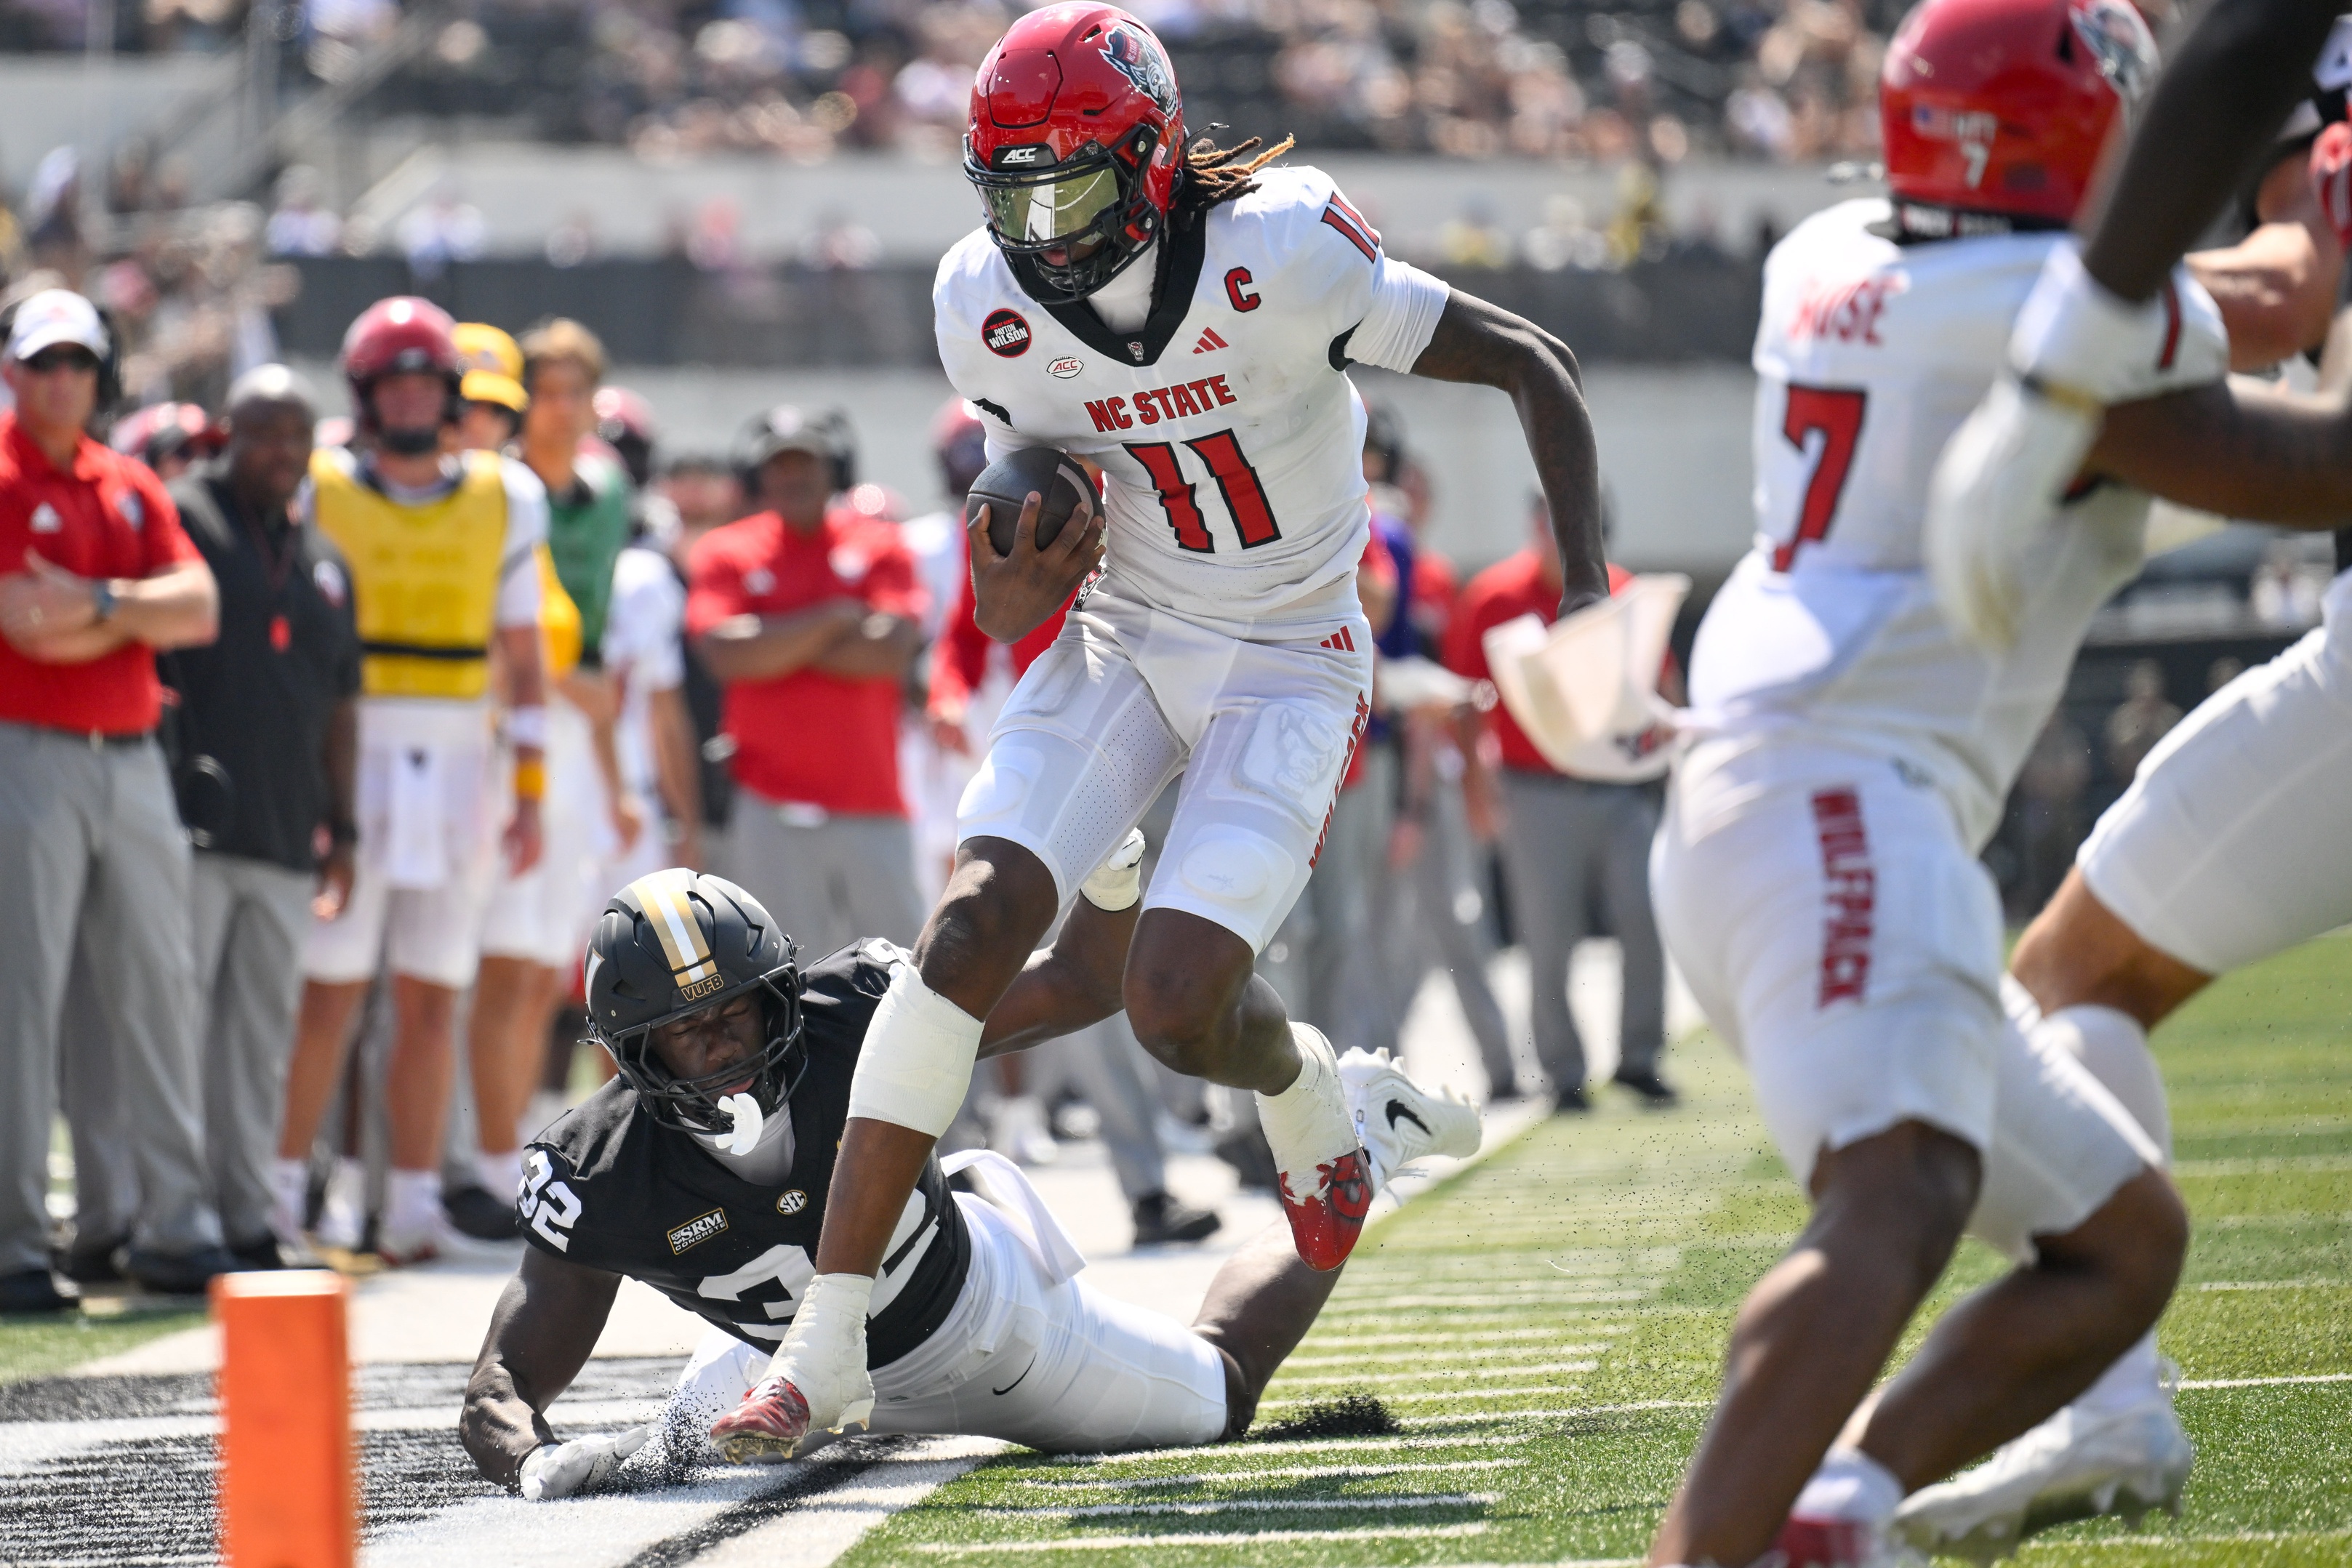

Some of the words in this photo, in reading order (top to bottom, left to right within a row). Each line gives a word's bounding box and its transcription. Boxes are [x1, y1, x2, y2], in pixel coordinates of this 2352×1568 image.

[1003, 148, 1037, 161] ACC
[1320, 190, 1380, 265] 11
[1224, 266, 1261, 313] C
[989, 327, 1029, 349] WILSON
[994, 323, 1016, 337] PAYTON
[1053, 360, 1077, 371] ACC
[1083, 396, 1133, 433] NC
[1132, 374, 1237, 425] STATE
[1121, 427, 1282, 554] 11
[1773, 382, 1869, 573] 7
[1811, 788, 1875, 1008] WOLFPACK
[681, 974, 723, 1001] VUFB
[517, 1150, 582, 1253] 32
[779, 1192, 804, 1213] SEC
[675, 1222, 726, 1251] CONCRETE
[680, 1212, 724, 1241] SRM
